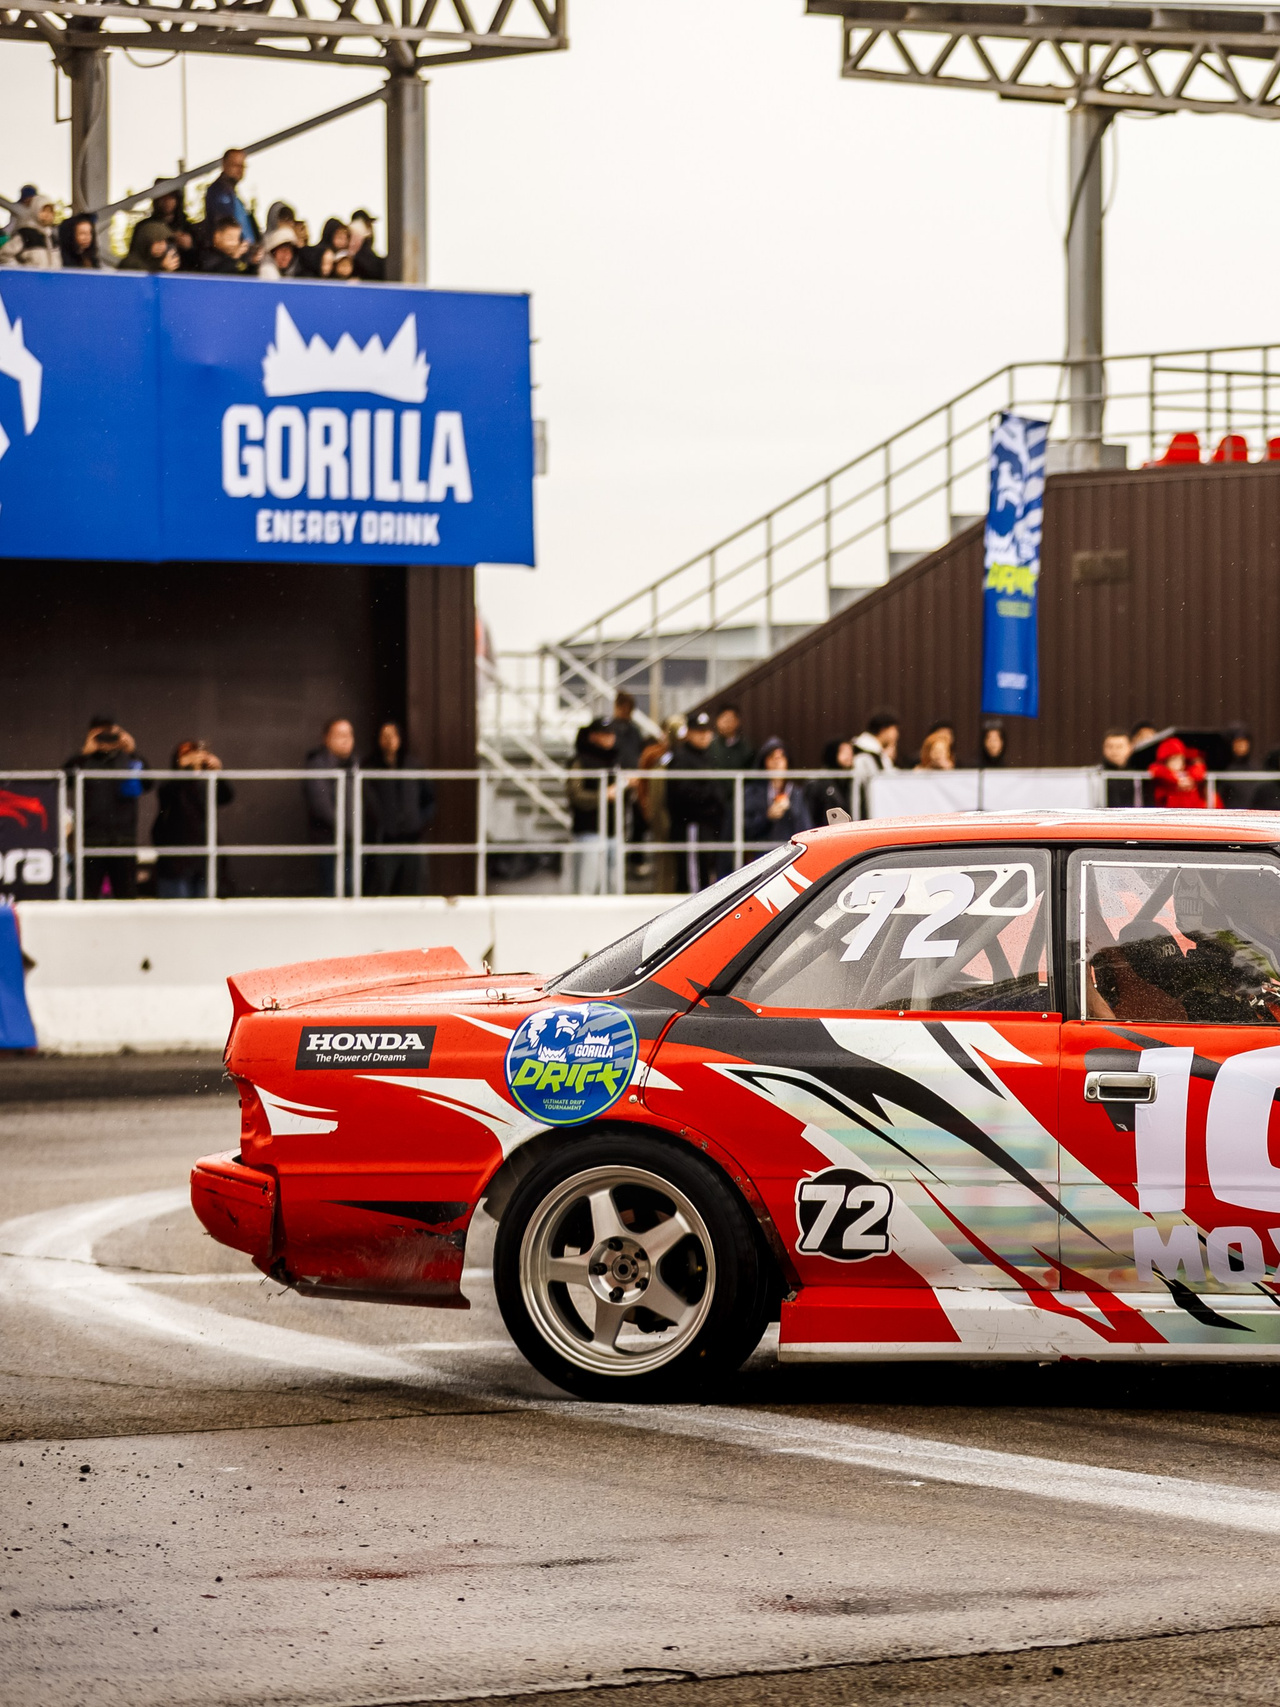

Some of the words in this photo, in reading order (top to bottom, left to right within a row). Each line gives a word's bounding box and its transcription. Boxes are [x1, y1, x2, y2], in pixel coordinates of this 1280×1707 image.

[221, 403, 473, 503] GORILLA
[256, 508, 358, 545] ENERGY
[361, 510, 441, 547] DRINK
[0, 848, 54, 885] ra
[839, 872, 976, 962] 72
[306, 1033, 426, 1051] HONDA
[316, 1053, 332, 1063] The
[333, 1053, 360, 1063] Power
[361, 1052, 373, 1062] of
[373, 1053, 406, 1062] Dreams
[574, 1044, 615, 1058] GORILLA
[512, 1058, 623, 1097] DRIFT
[801, 1184, 890, 1250] 72
